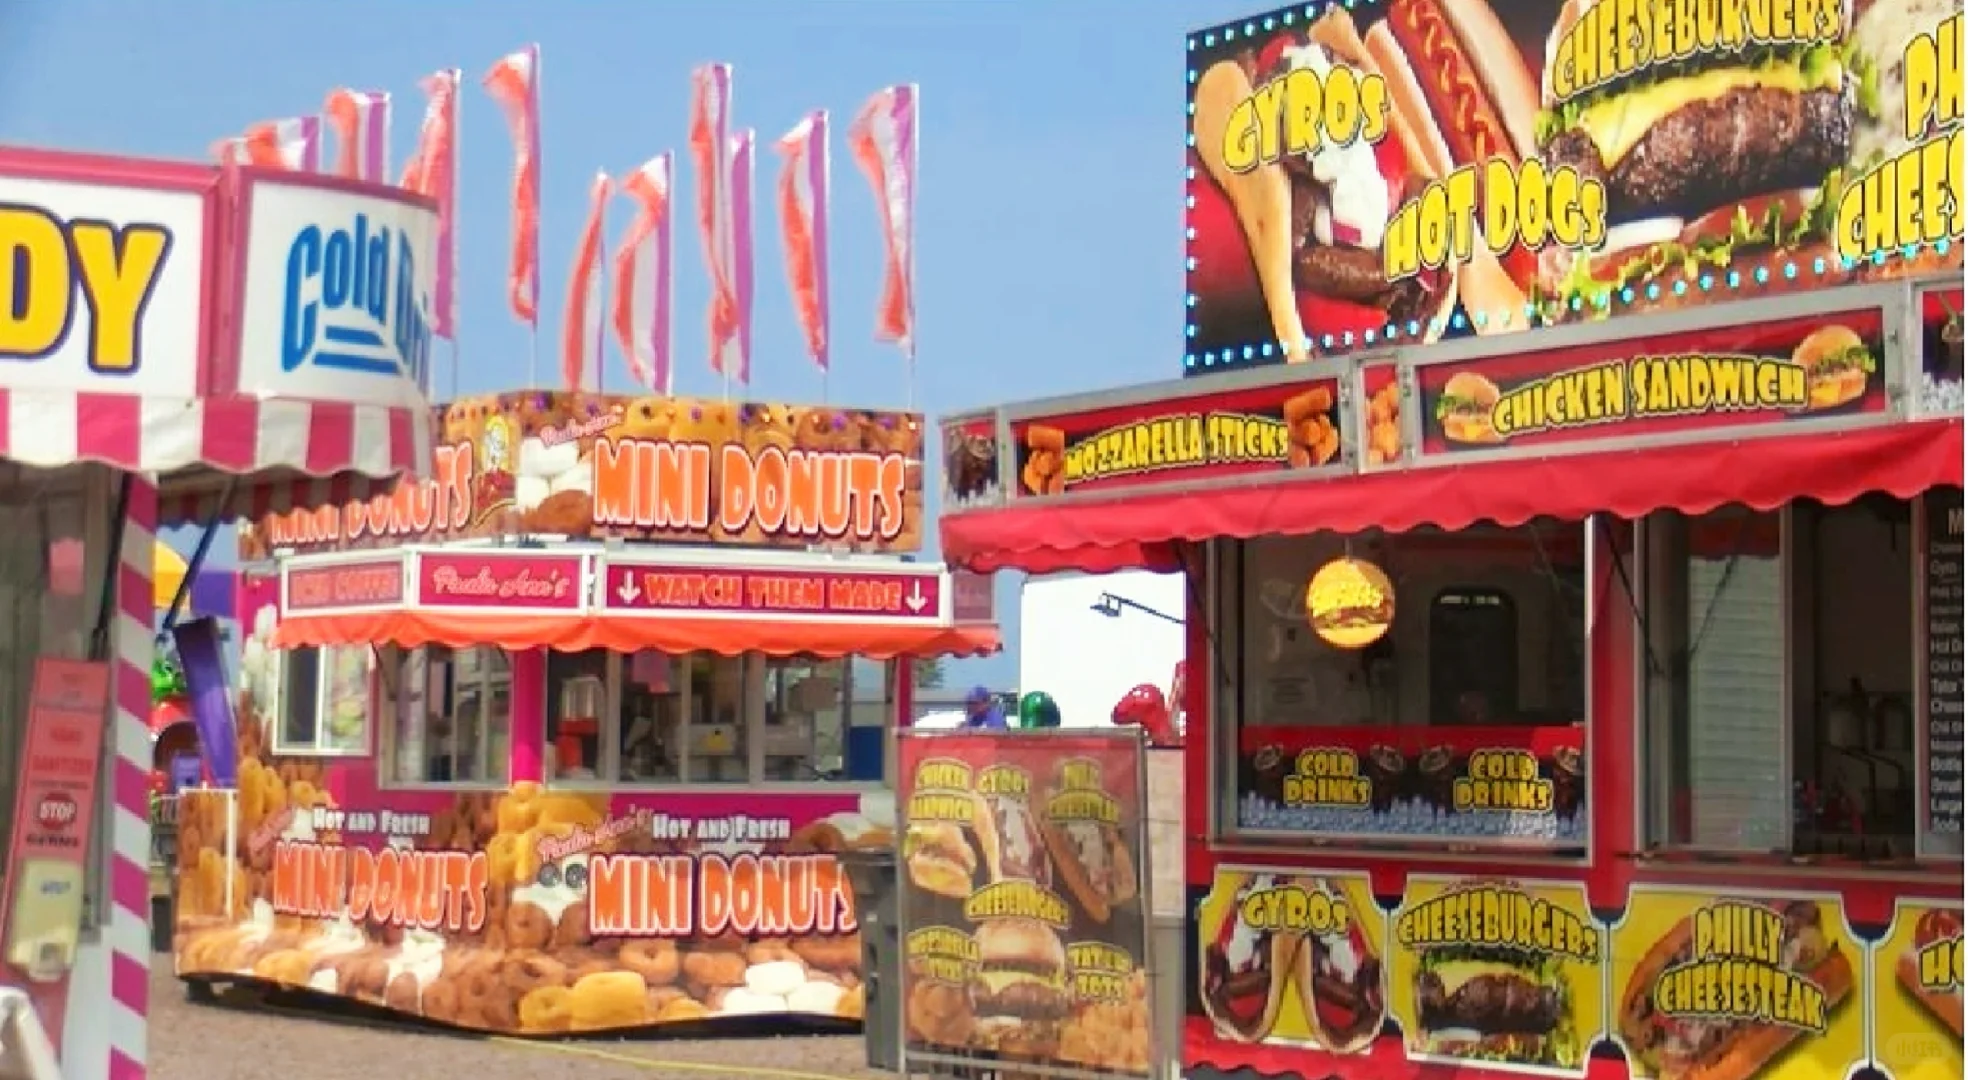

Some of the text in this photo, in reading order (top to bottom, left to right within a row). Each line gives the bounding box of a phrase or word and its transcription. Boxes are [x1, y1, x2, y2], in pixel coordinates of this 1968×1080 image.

[1553, 0, 1841, 98] CHEESEBURGERS
[1904, 12, 1963, 139] PH
[1222, 64, 1386, 172] GYROS
[1384, 157, 1606, 282] HOT DOGS
[0, 203, 173, 373] DY
[282, 213, 389, 372] Cold
[1492, 354, 1807, 435] CHICKEN SANDWICH
[1064, 412, 1289, 481] MOZZARELLA STICKS
[593, 438, 905, 538] MINI DONUTS
[433, 565, 497, 594] Paula
[645, 573, 902, 611] WATCH THEM MADE
[1285, 778, 1370, 804] DRINKS
[1299, 753, 1355, 777] COLD
[1455, 780, 1552, 810] DRINKS
[1470, 752, 1537, 780] COLD
[40, 801, 75, 820] STOP
[313, 806, 344, 830] HOT
[381, 809, 430, 834] FRESH
[652, 813, 791, 839] HOT AND FRESH
[274, 841, 487, 931] MINI DONUTS
[590, 853, 857, 936] MINI DONUTS
[1244, 887, 1349, 932] GYROS
[1398, 889, 1597, 957] CHEESEBURGERS
[1695, 904, 1782, 964] PHILLY
[1658, 960, 1825, 1030] CHEESESTEAK
